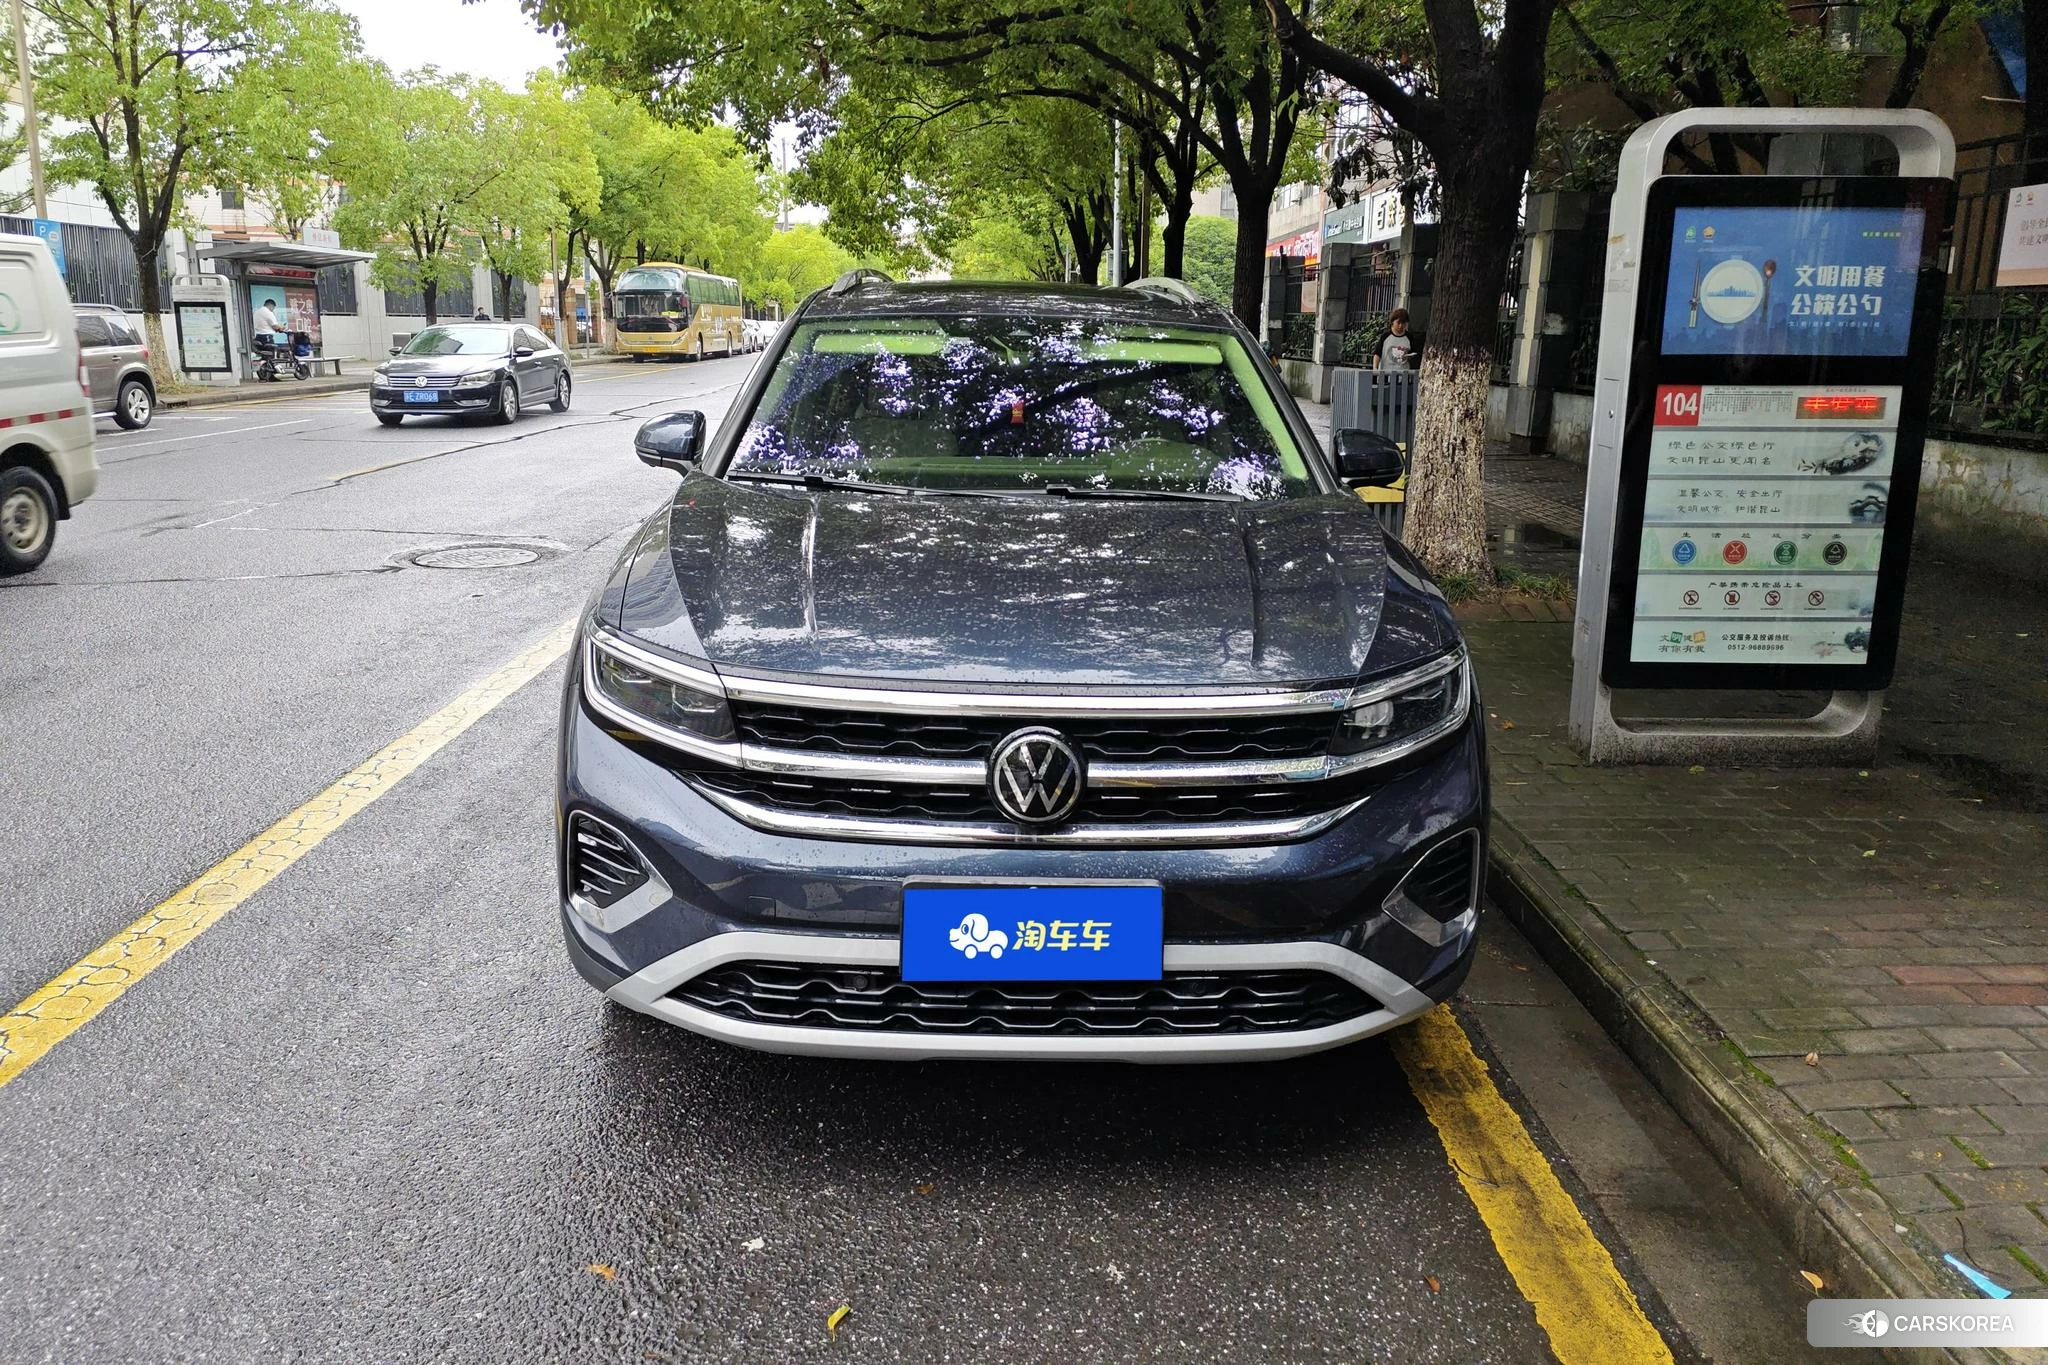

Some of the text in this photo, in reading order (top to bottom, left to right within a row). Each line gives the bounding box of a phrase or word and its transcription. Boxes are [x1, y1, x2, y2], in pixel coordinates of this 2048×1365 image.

[1794, 265, 1887, 287] 文明用餐
[1790, 293, 1882, 316] 公筷公勺
[1662, 392, 1698, 416] 104
